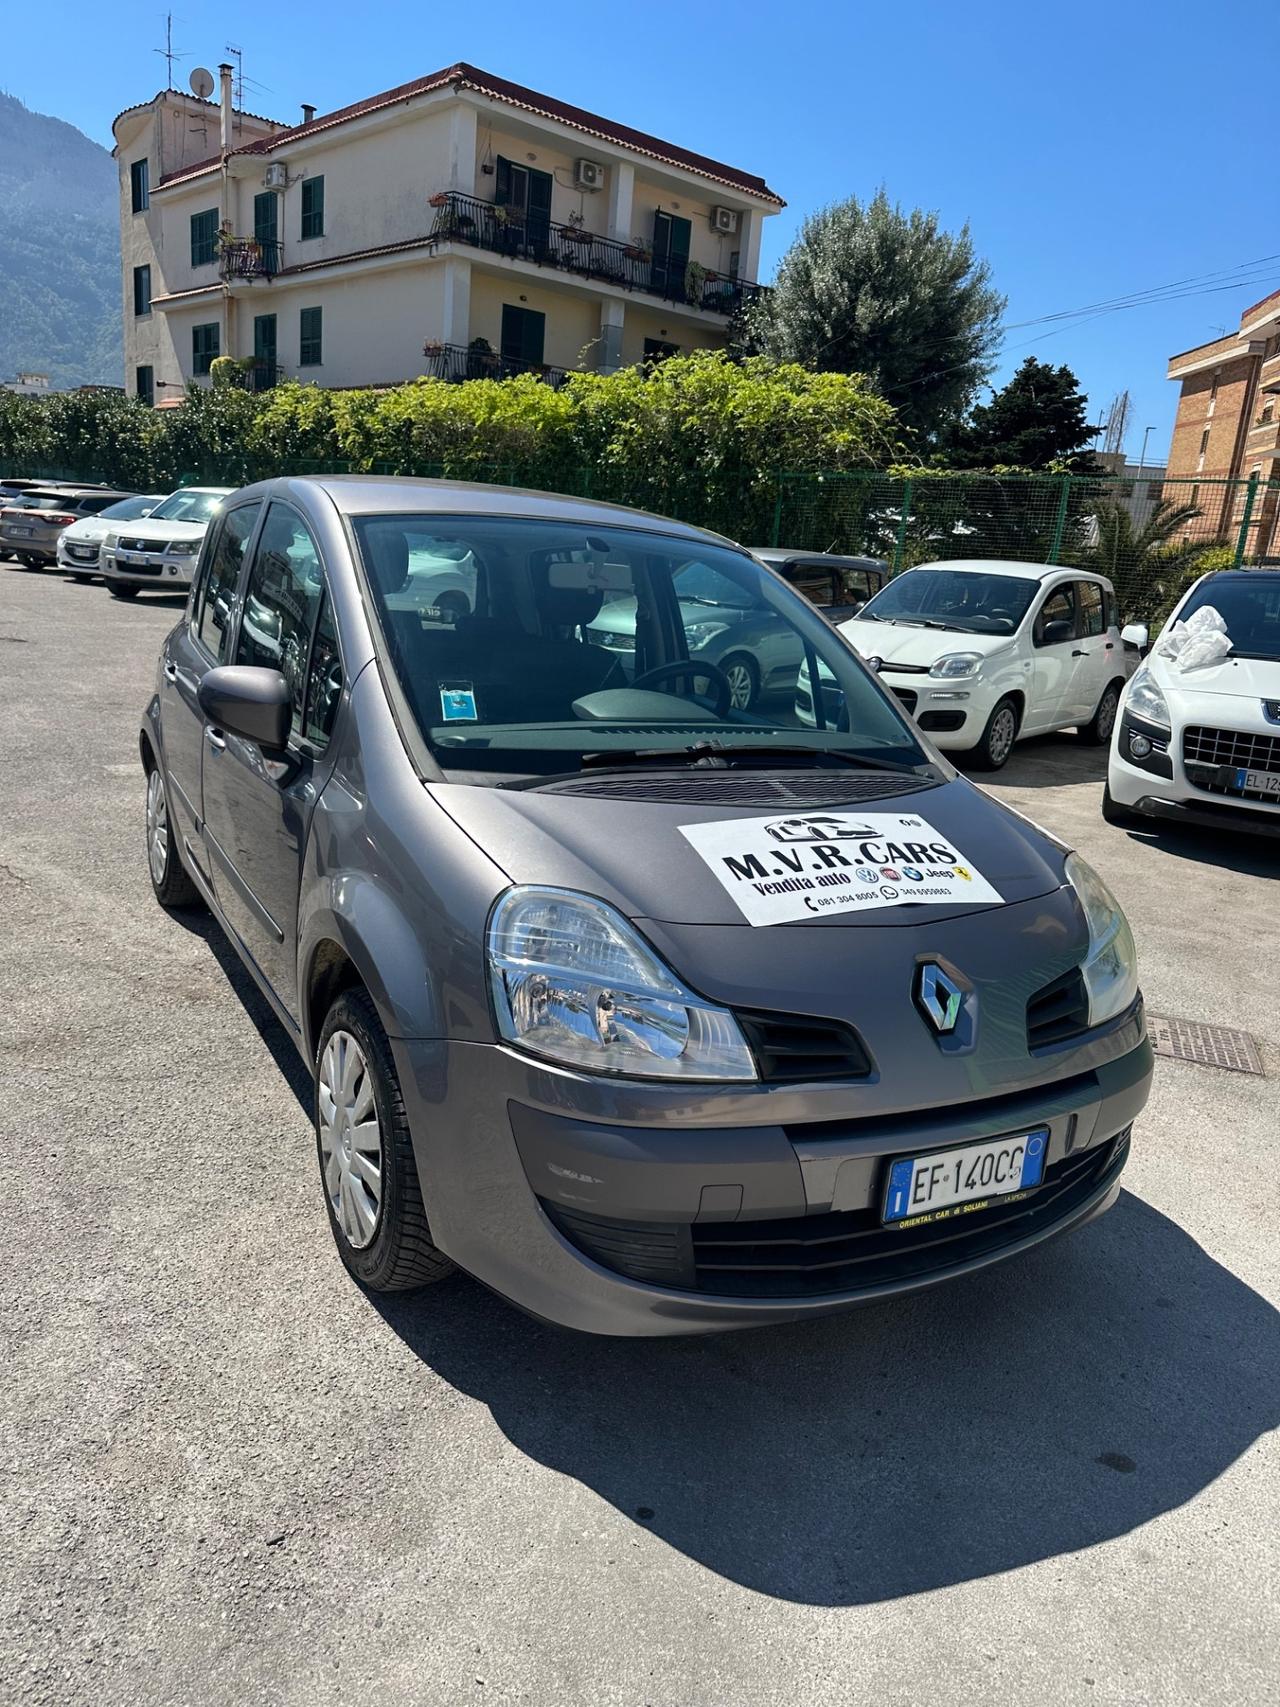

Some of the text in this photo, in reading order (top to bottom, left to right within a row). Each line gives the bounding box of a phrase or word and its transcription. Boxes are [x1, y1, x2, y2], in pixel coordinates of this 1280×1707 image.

[1246, 774, 1260, 788] EL
[722, 841, 957, 881] M.V.R.CARS
[751, 877, 813, 897] Vendita
[818, 872, 851, 887] auto
[926, 868, 954, 879] Jeep
[817, 891, 879, 906] 081 304 8005
[912, 1163, 945, 1205] EF
[899, 1214, 932, 1229] ORIENTAL
[935, 1209, 950, 1220] CAR
